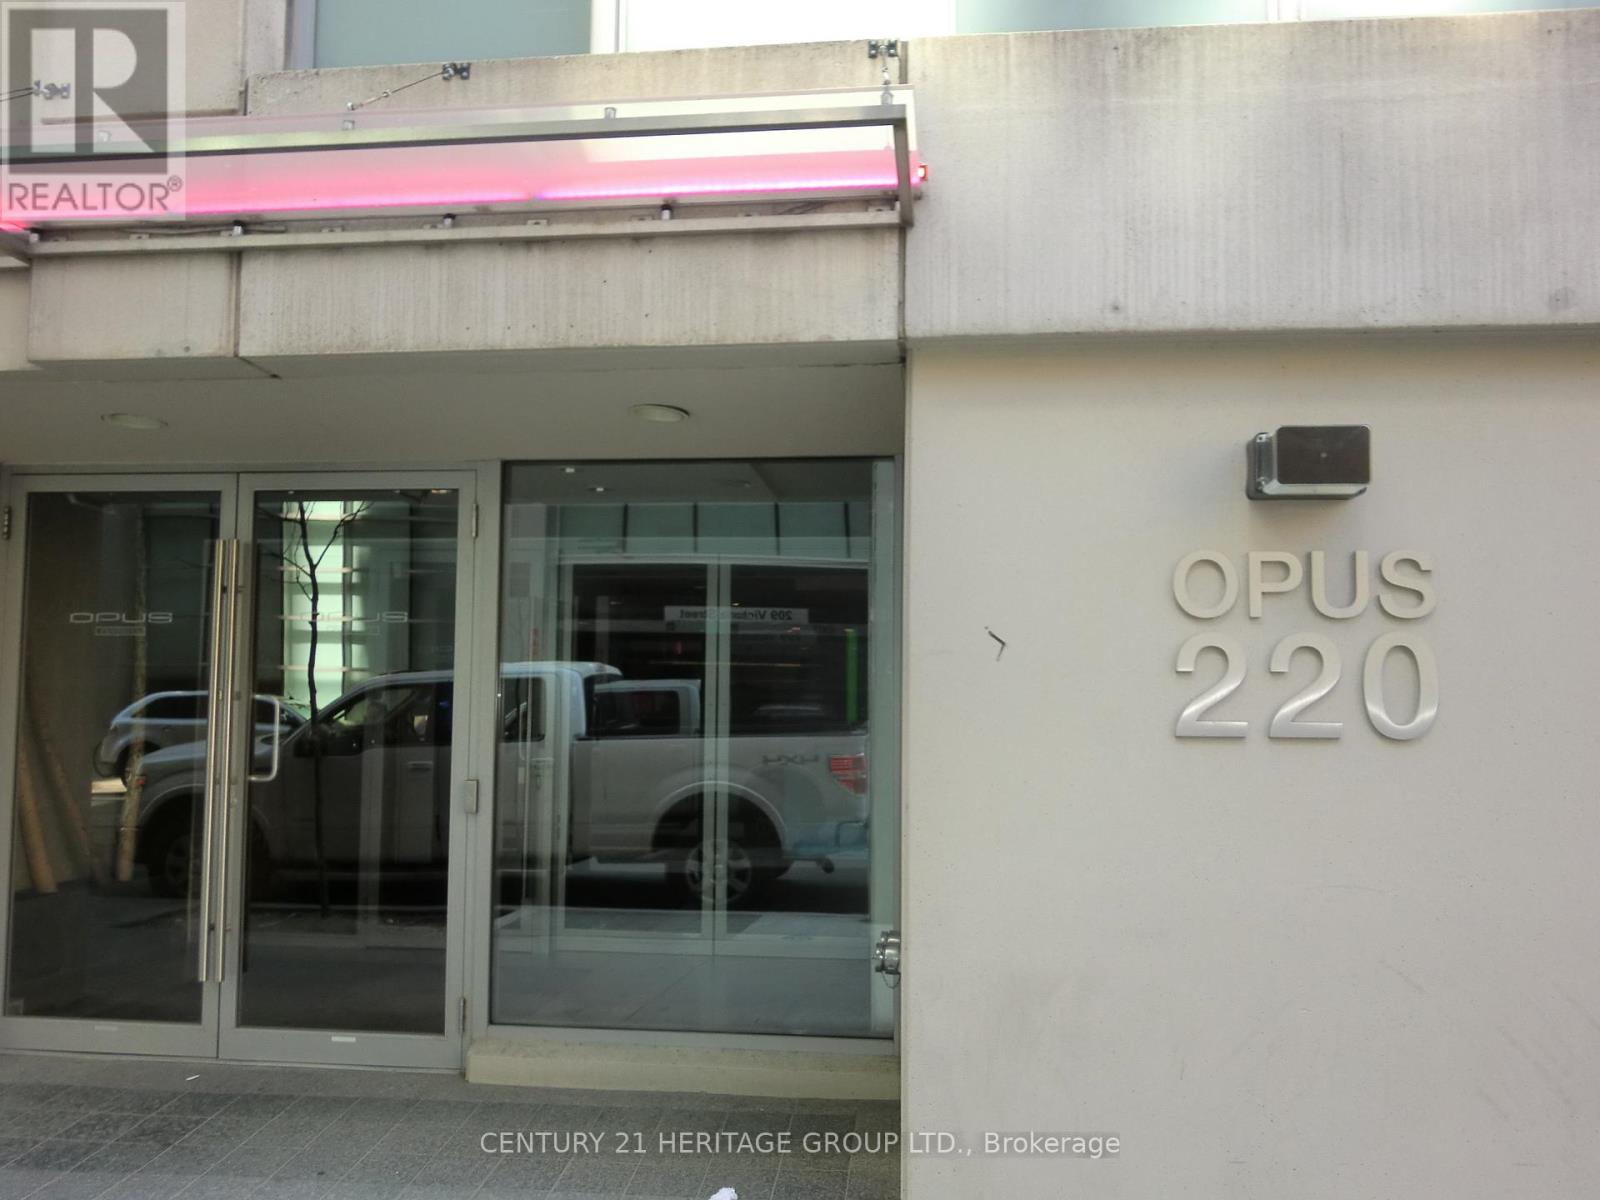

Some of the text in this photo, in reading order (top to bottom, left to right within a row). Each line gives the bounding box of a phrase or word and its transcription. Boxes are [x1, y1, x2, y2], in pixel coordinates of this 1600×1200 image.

[70, 612, 173, 623] OPUS
[1172, 550, 1437, 619] OPUS
[1175, 631, 1439, 740] 220
